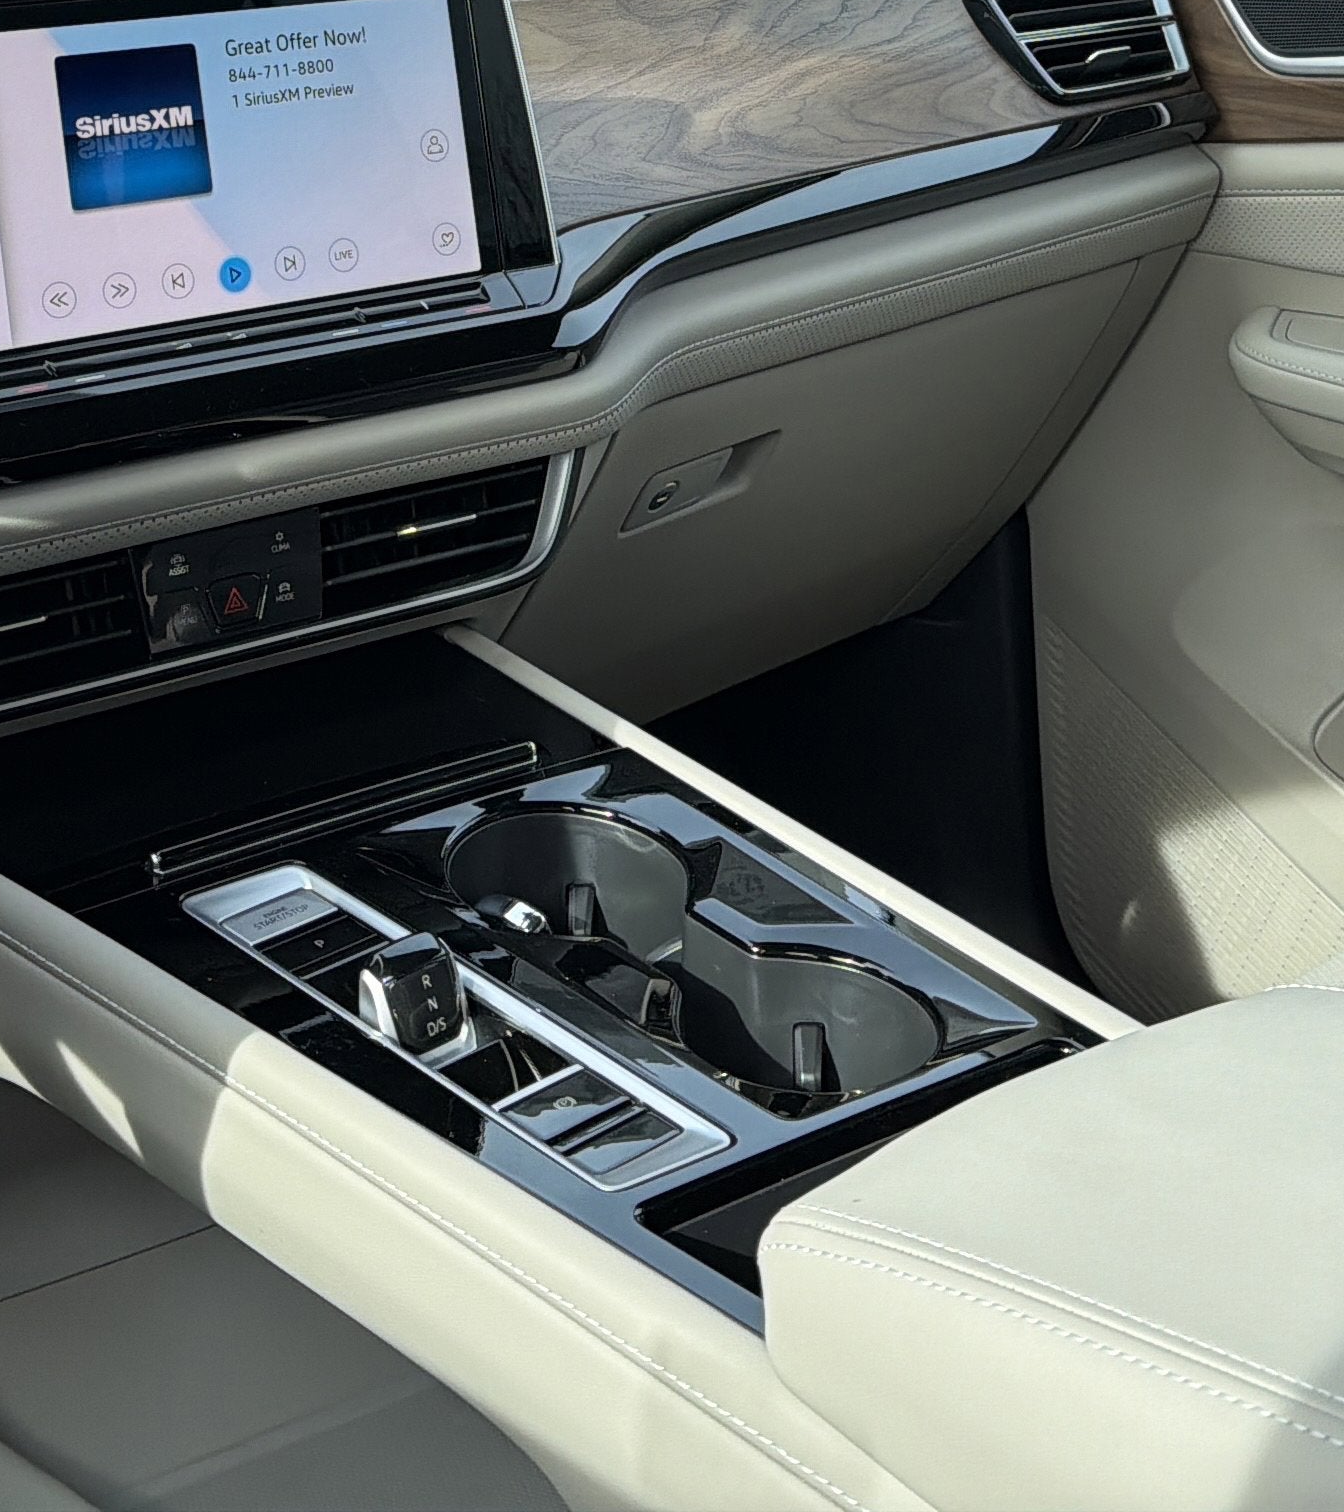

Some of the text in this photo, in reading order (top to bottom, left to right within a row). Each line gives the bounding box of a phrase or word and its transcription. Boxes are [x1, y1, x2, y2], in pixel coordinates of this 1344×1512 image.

[225, 26, 368, 57] Great Offer Now!
[228, 58, 335, 83] 844-711-8800
[232, 83, 355, 108] 1 SiriusXM Preview
[75, 104, 194, 139] SiriusXM
[334, 249, 354, 261] LIVE
[270, 541, 291, 554] CLIMA
[168, 564, 191, 577] ASSIST
[275, 590, 295, 603] MODE
[313, 939, 325, 949] P
[421, 974, 433, 990] R
[426, 995, 439, 1012] N
[426, 1016, 448, 1038] D/S
